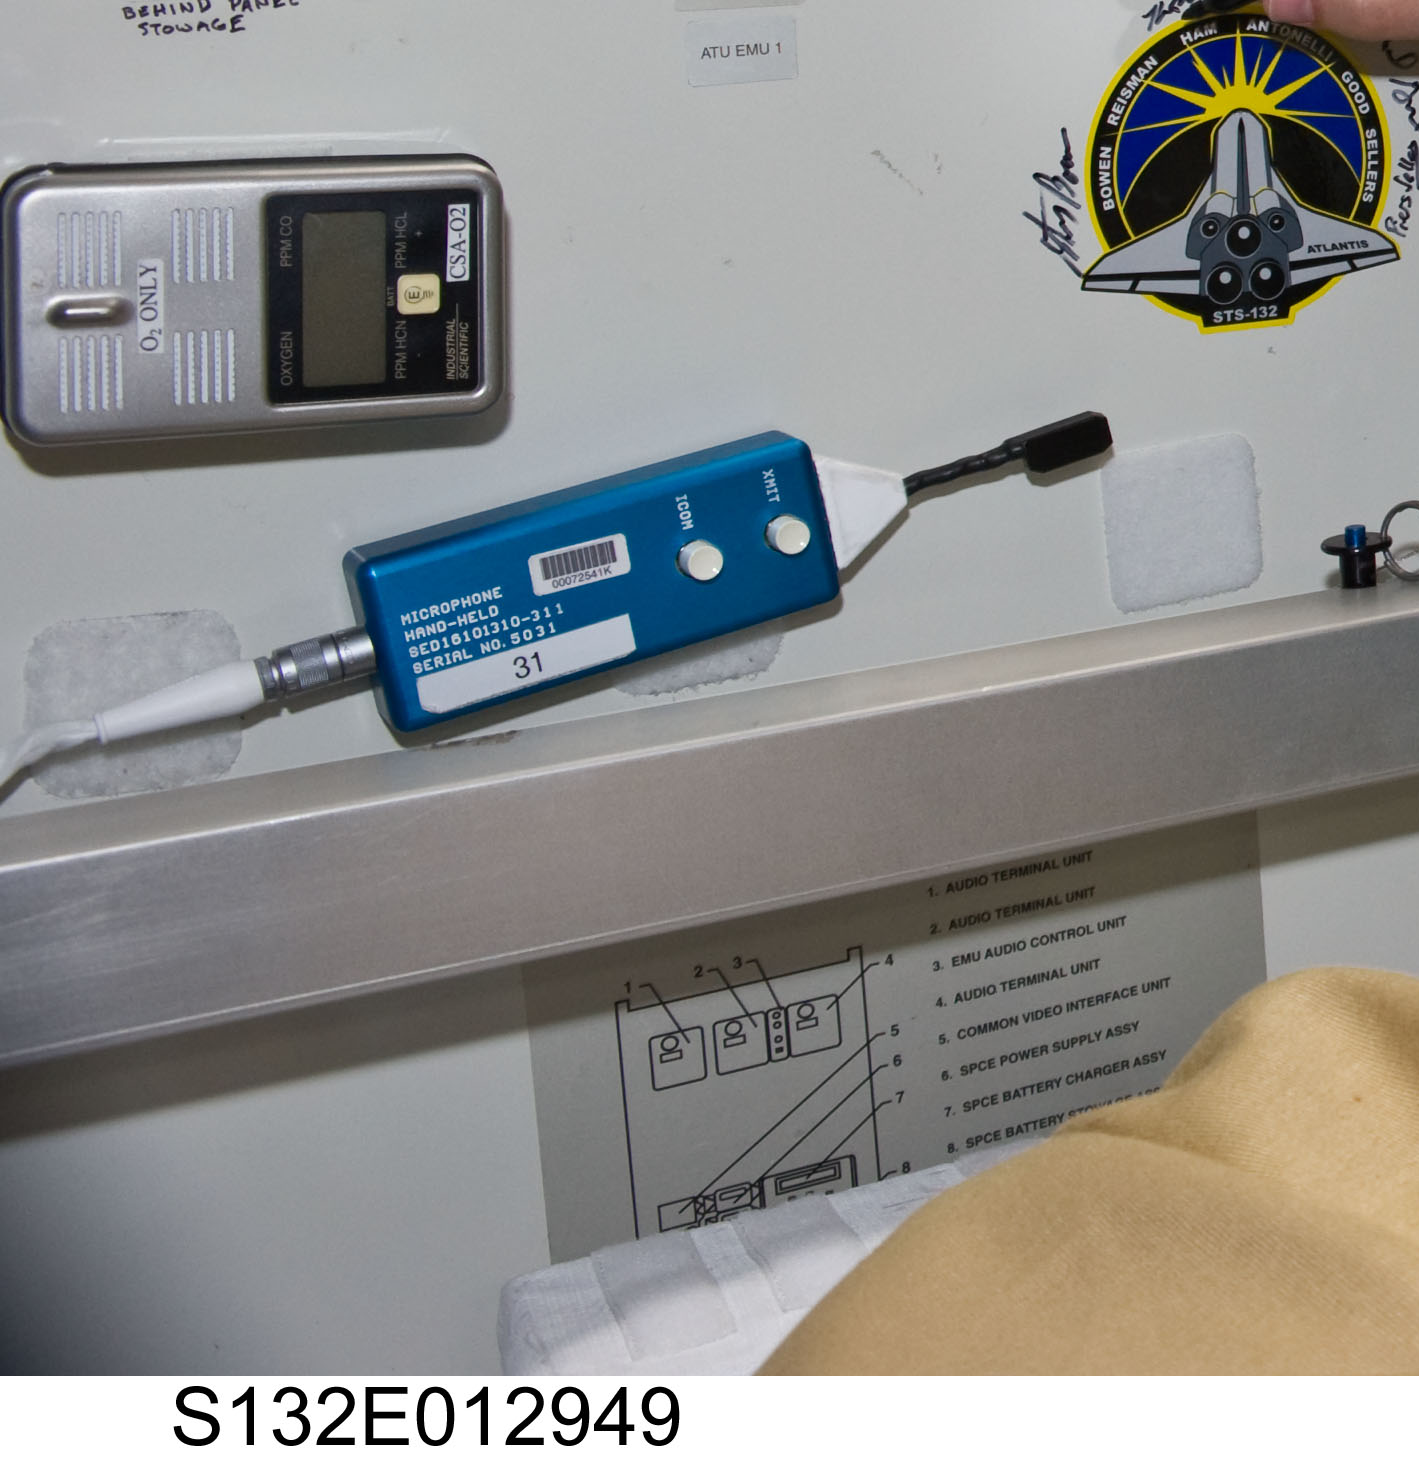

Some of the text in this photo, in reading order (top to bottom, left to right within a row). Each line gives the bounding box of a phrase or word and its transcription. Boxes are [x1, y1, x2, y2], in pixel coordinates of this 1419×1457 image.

[138, 14, 246, 36] STOWAGE
[1180, 22, 1218, 45] HAM
[1246, 19, 1333, 62] ANTONELLI
[701, 42, 781, 59] ATU EMU 1
[1108, 56, 1159, 127] REISMAN
[1341, 71, 1370, 114] GOOD
[1099, 146, 1115, 211] BOWEN
[1362, 128, 1378, 202] SELLERS
[449, 207, 466, 279] CSA-O2
[1307, 240, 1369, 254] ATLANTIS
[139, 265, 158, 322] ONLY
[1213, 305, 1277, 323] STS-132
[280, 331, 293, 386] OXYGEN
[446, 318, 456, 380] INDUSTRIAL
[459, 320, 470, 380] SCIENTIFIC
[762, 469, 780, 502] XMIT
[675, 494, 694, 530] ICOM
[400, 586, 503, 627] MICROPHONE
[404, 604, 501, 643] HAND-HELD
[411, 622, 556, 674] SERIAL NO. 5031
[513, 652, 542, 679] 31
[945, 850, 1093, 894] AUDIO TERMINAL UNIT
[948, 886, 1095, 931] AUDIO TERMINAL UNIT
[951, 915, 1127, 967] EMU AUDIO CONTROL UNIT
[954, 958, 1101, 1004] AUDIO TERMINAL UNIT
[957, 977, 1171, 1040] COMMON VIDEO INTERFACE UNIT
[960, 1020, 1139, 1076] SPCE POWER SUPPLY ASSY
[963, 1049, 1167, 1112] SPCE BATTERY CHARGER ASSY
[966, 1112, 1065, 1149] SPCE BATTERY
